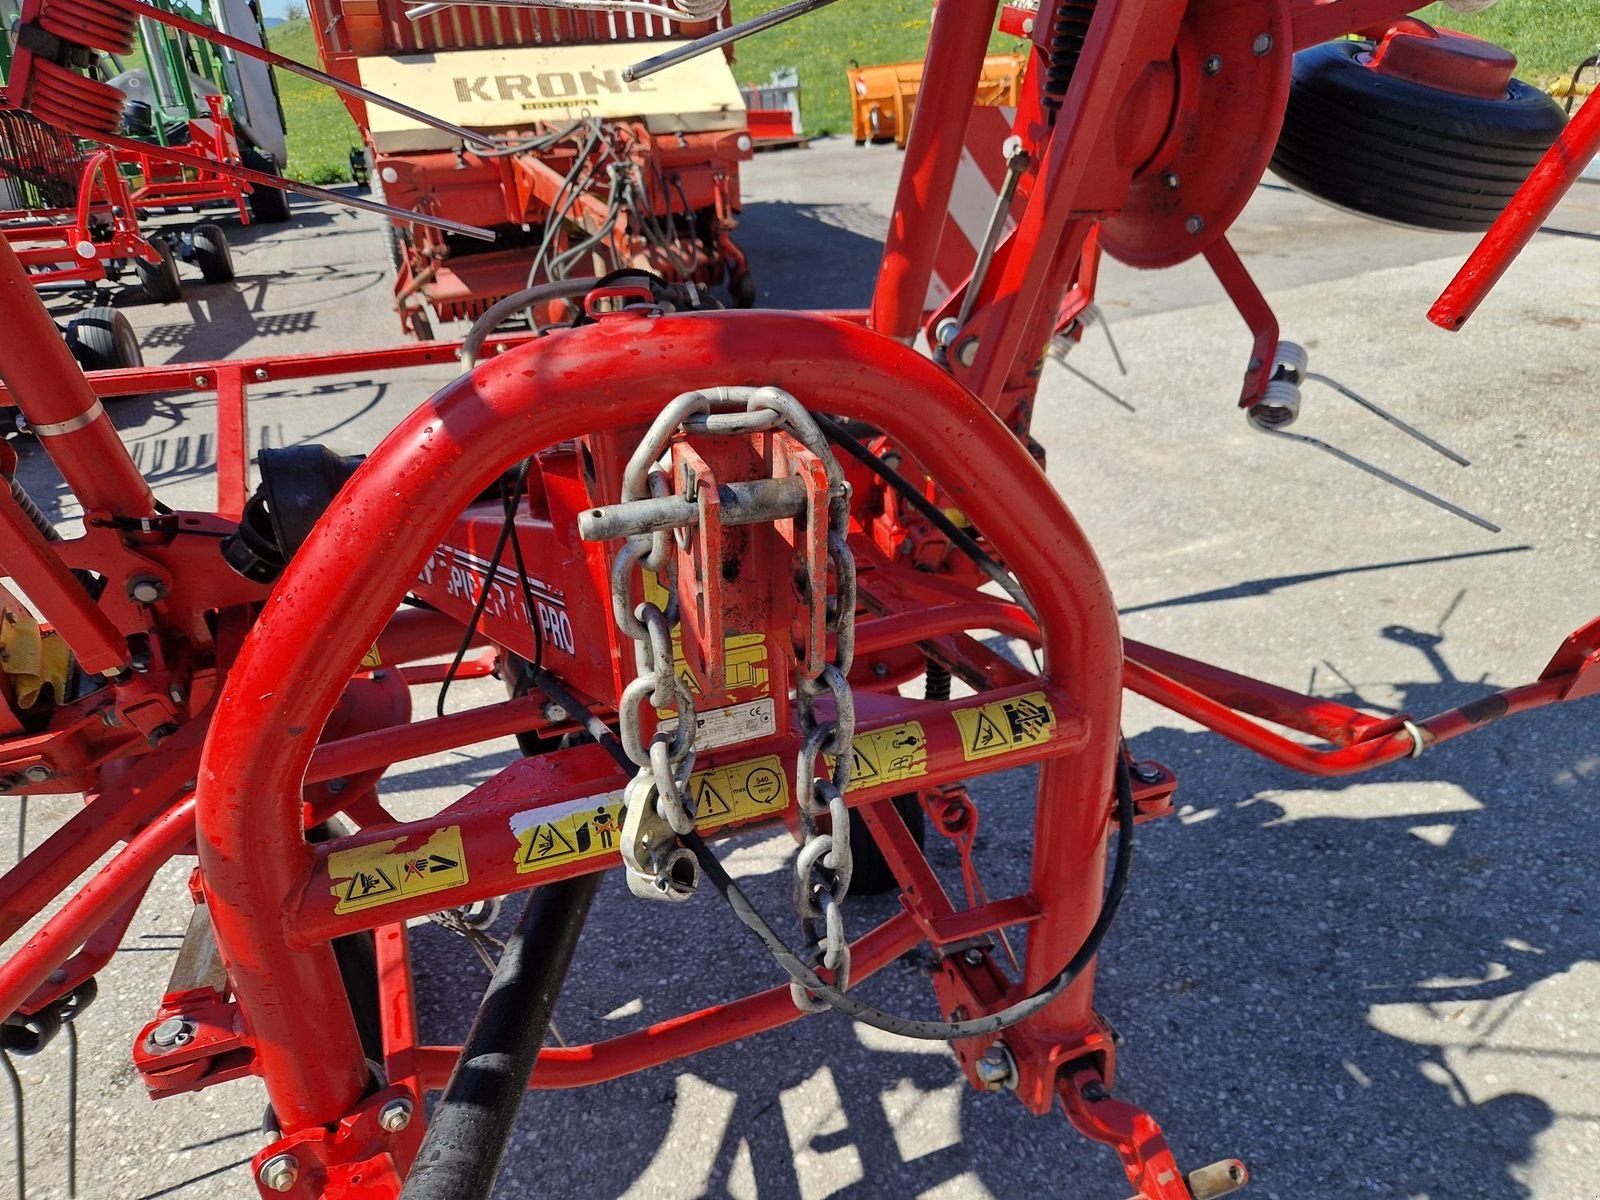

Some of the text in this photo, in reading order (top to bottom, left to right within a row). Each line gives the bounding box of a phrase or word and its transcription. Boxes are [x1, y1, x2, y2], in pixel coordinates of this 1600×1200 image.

[537, 601, 576, 656] PRO
[756, 775, 769, 784] 540
[732, 786, 747, 794] max
[758, 786, 772, 794] min
